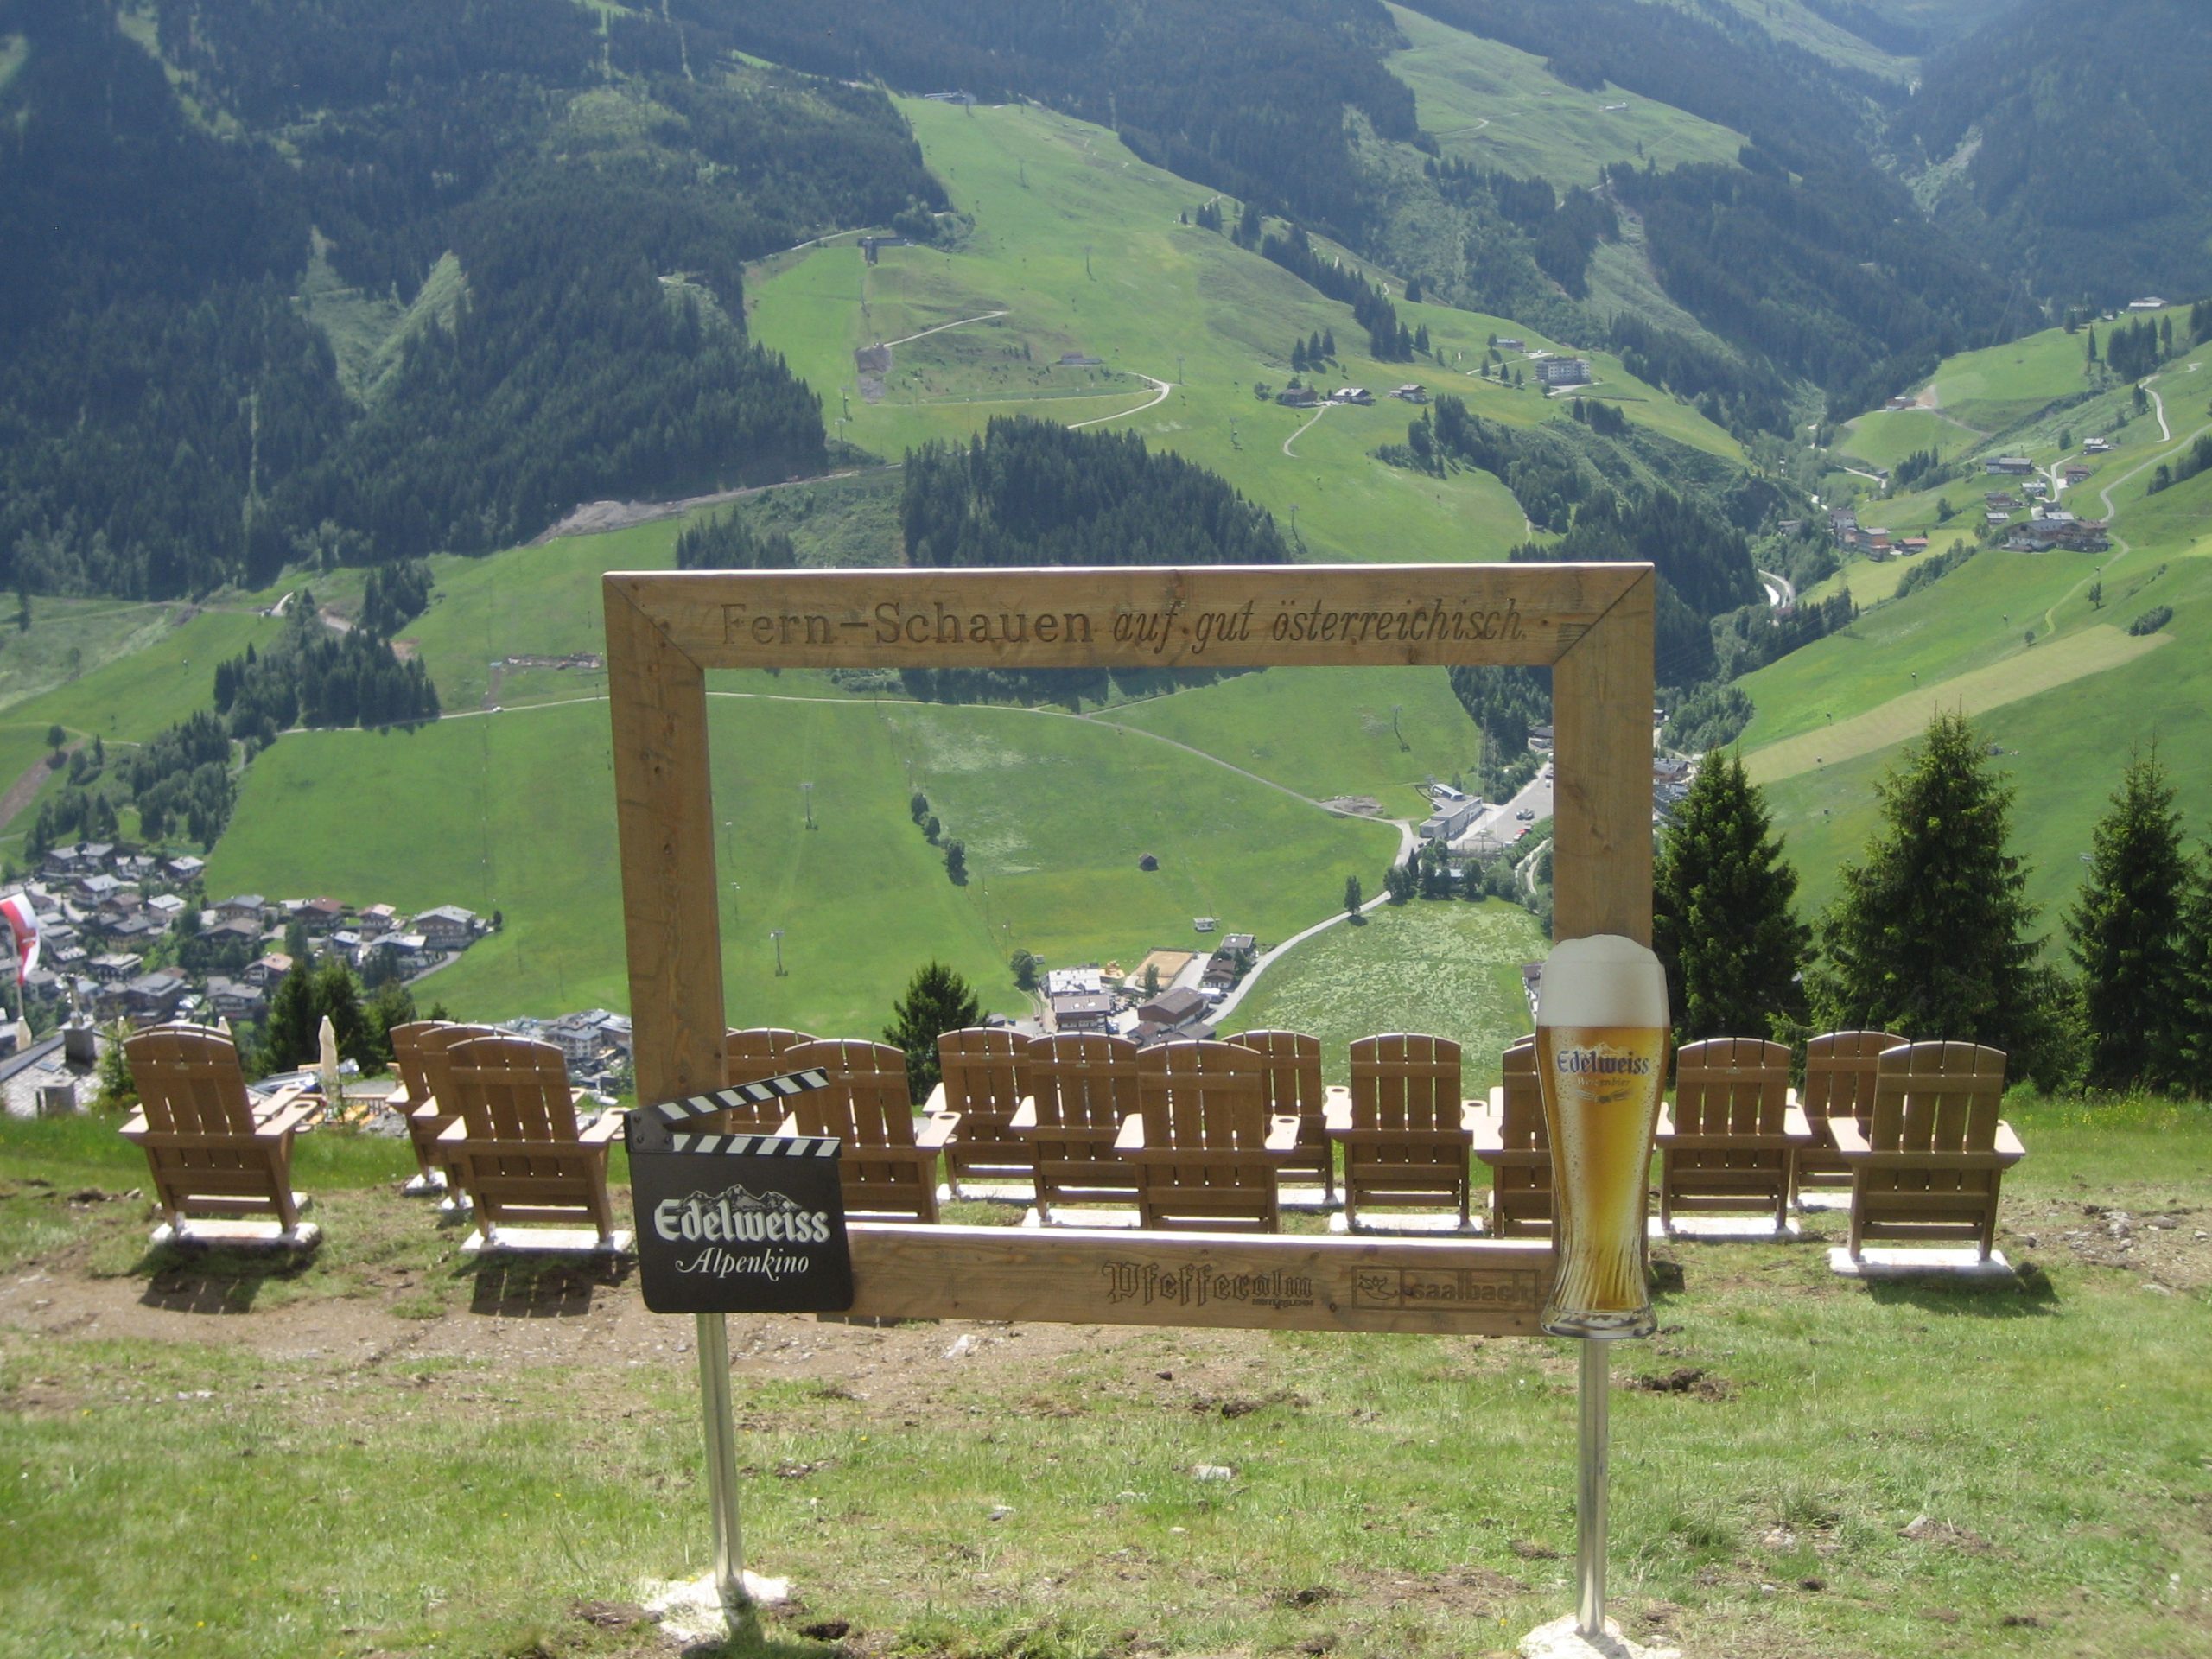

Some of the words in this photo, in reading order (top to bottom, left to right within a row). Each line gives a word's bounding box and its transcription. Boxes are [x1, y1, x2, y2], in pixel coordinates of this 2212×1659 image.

[721, 602, 1095, 645] Fern-Schauen
[1114, 600, 1181, 654] auf
[1192, 600, 1255, 654] gut
[1556, 1050, 1649, 1075] Edelweiss
[654, 1198, 831, 1243] Edelweiss
[674, 1247, 810, 1282] Alpenkino
[1101, 1261, 1313, 1306] Pfefferalm
[1413, 1270, 1529, 1302] saalbach
